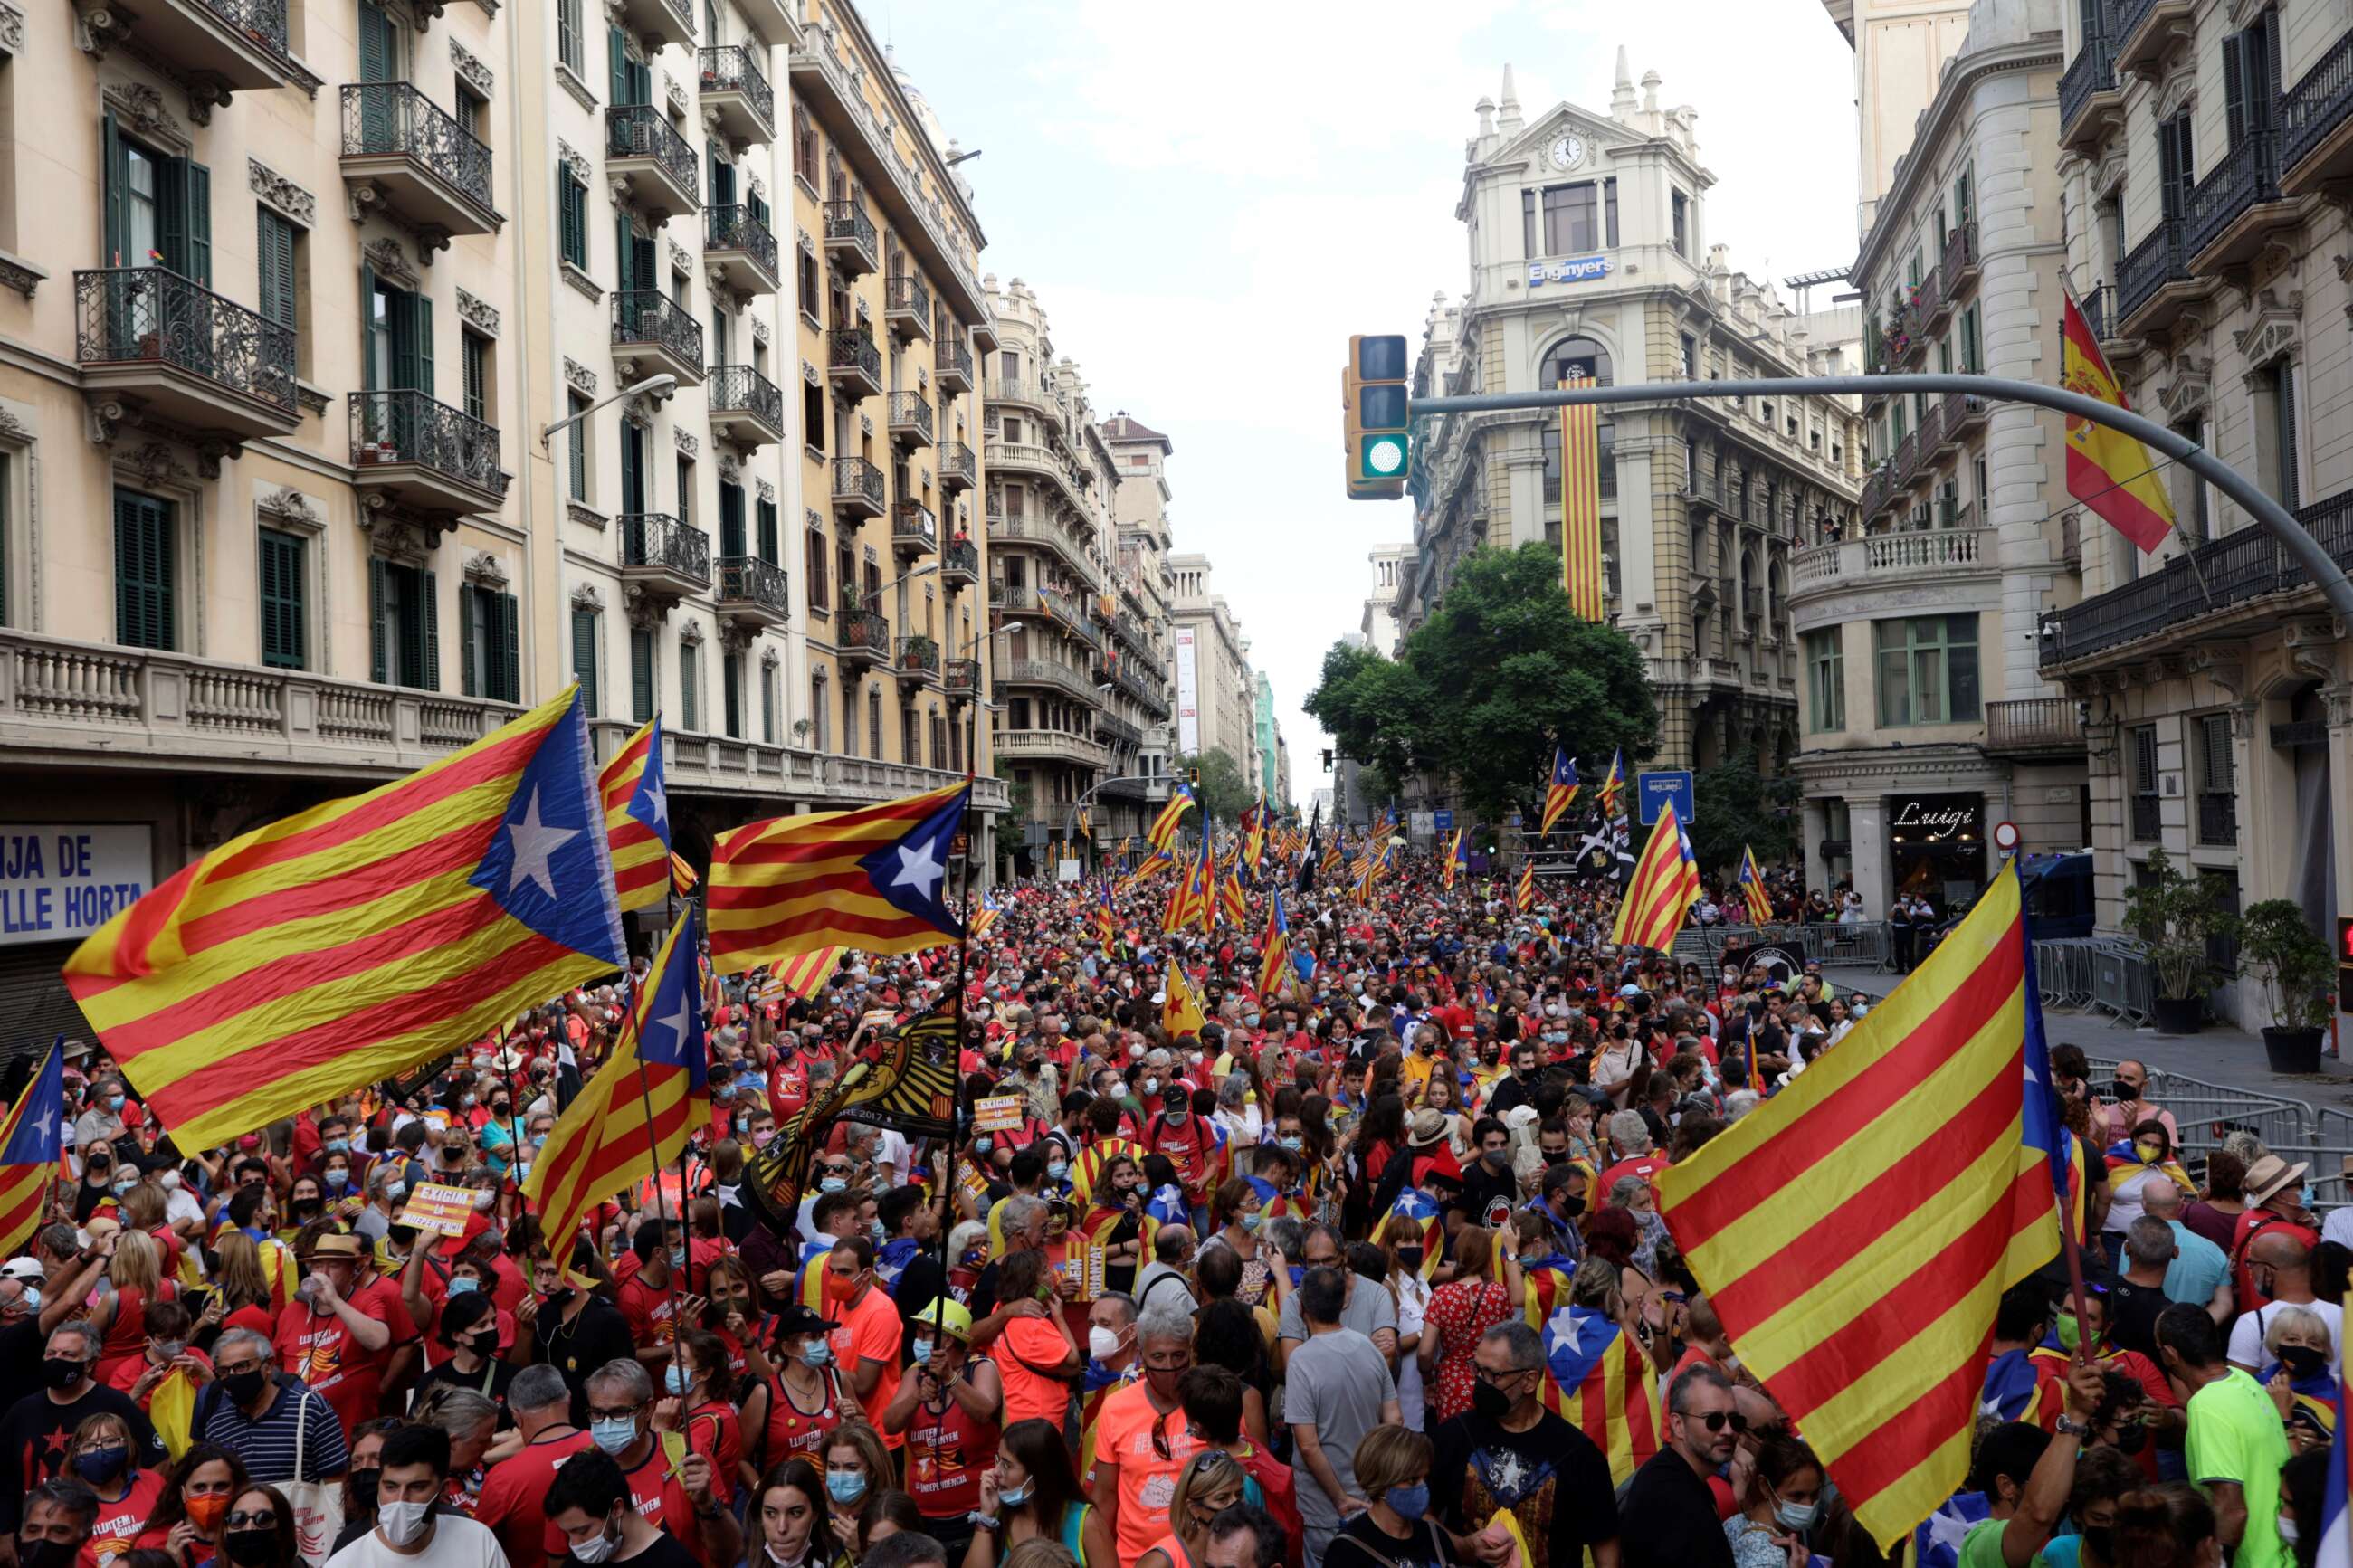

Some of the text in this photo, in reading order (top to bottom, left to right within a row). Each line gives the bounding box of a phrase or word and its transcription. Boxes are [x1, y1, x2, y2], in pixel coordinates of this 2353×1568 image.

[1529, 260, 1615, 281] Enginyers
[1894, 802, 1974, 838] Luigi
[58, 835, 91, 878] DE
[0, 888, 52, 934] LLE
[980, 1098, 1015, 1110] EXIGIM
[859, 1109, 883, 1121] 2017
[420, 1186, 469, 1205] EXIGIM
[1089, 1245, 1102, 1297] GUANYAT
[115, 1520, 147, 1539] GUANY
